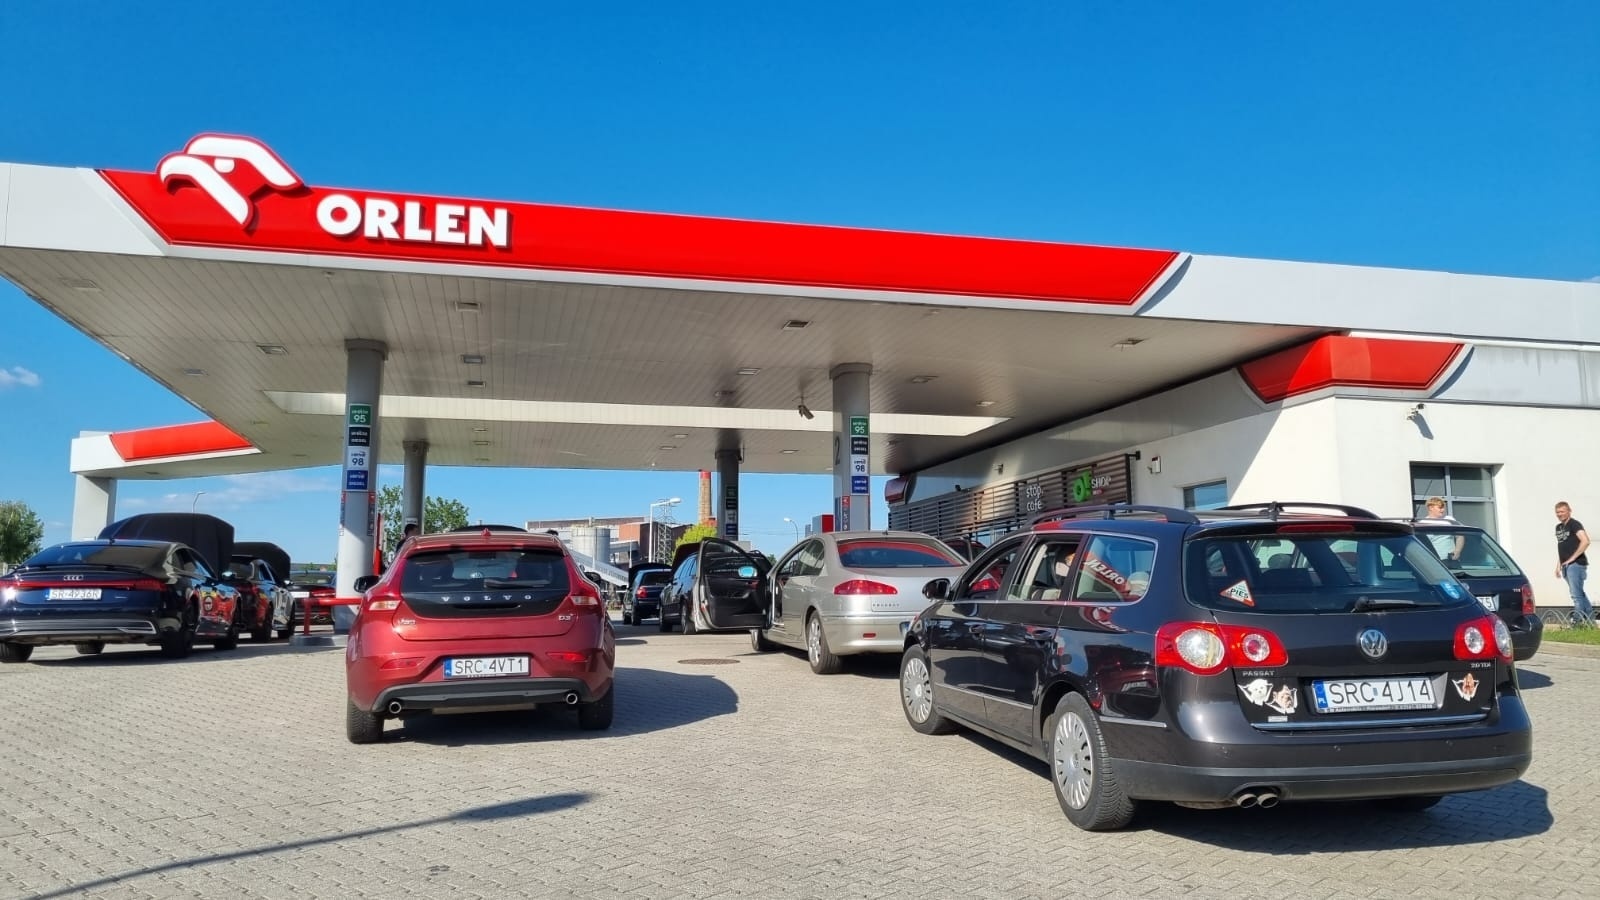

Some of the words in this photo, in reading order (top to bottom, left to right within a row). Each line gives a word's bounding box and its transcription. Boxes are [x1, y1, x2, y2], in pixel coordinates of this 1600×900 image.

[316, 193, 508, 247] ORLEN
[353, 414, 366, 423] 95
[854, 426, 865, 434] 95
[351, 457, 364, 466] 98
[855, 464, 866, 473] 98
[1026, 498, 1043, 511] cafe
[441, 594, 532, 602] VOLVO
[1230, 587, 1249, 599] PIES
[455, 659, 483, 675] SRC
[488, 658, 523, 673] 4VT1
[1328, 681, 1375, 705] SRC
[1381, 680, 1431, 703] 4J14
